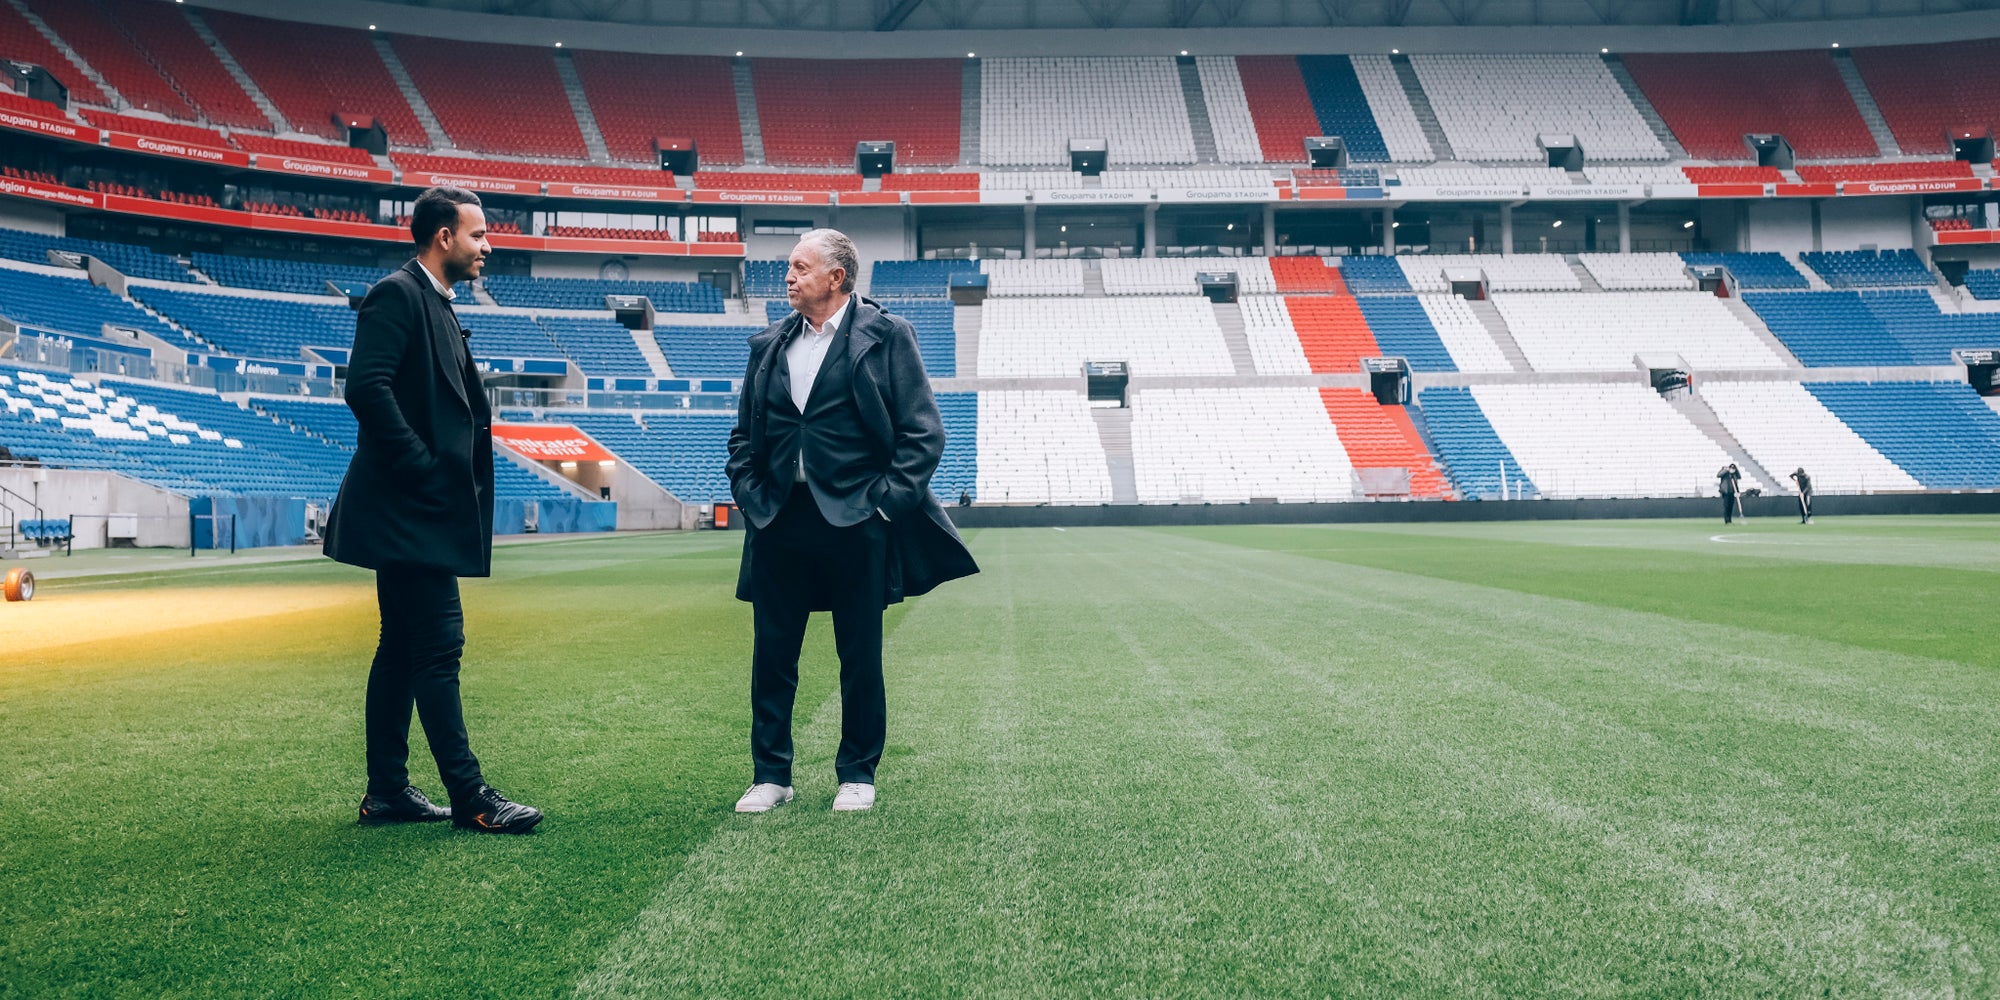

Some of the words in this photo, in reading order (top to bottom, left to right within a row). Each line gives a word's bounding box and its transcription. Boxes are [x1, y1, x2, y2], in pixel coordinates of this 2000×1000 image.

[0, 113, 38, 129] oupama
[40, 122, 76, 136] STADIUM
[137, 138, 185, 154] Groupama
[187, 148, 223, 160] STADIUM
[283, 160, 330, 174] Groupama
[332, 167, 368, 178] STADIUM
[0, 180, 26, 193] égion
[430, 175, 478, 188] Groupama
[480, 182, 516, 191] STADIUM
[1869, 182, 1917, 192] Groupama
[1919, 182, 1956, 191] STADIUM
[572, 186, 619, 197] Groupama
[621, 190, 657, 198] STADIUM
[720, 192, 766, 202] Groupama
[1050, 191, 1097, 201] Groupama
[1186, 190, 1232, 199] Groupama
[1436, 187, 1480, 197] Groupama
[1546, 187, 1592, 196] Groupama
[246, 363, 280, 376] deliveroo
